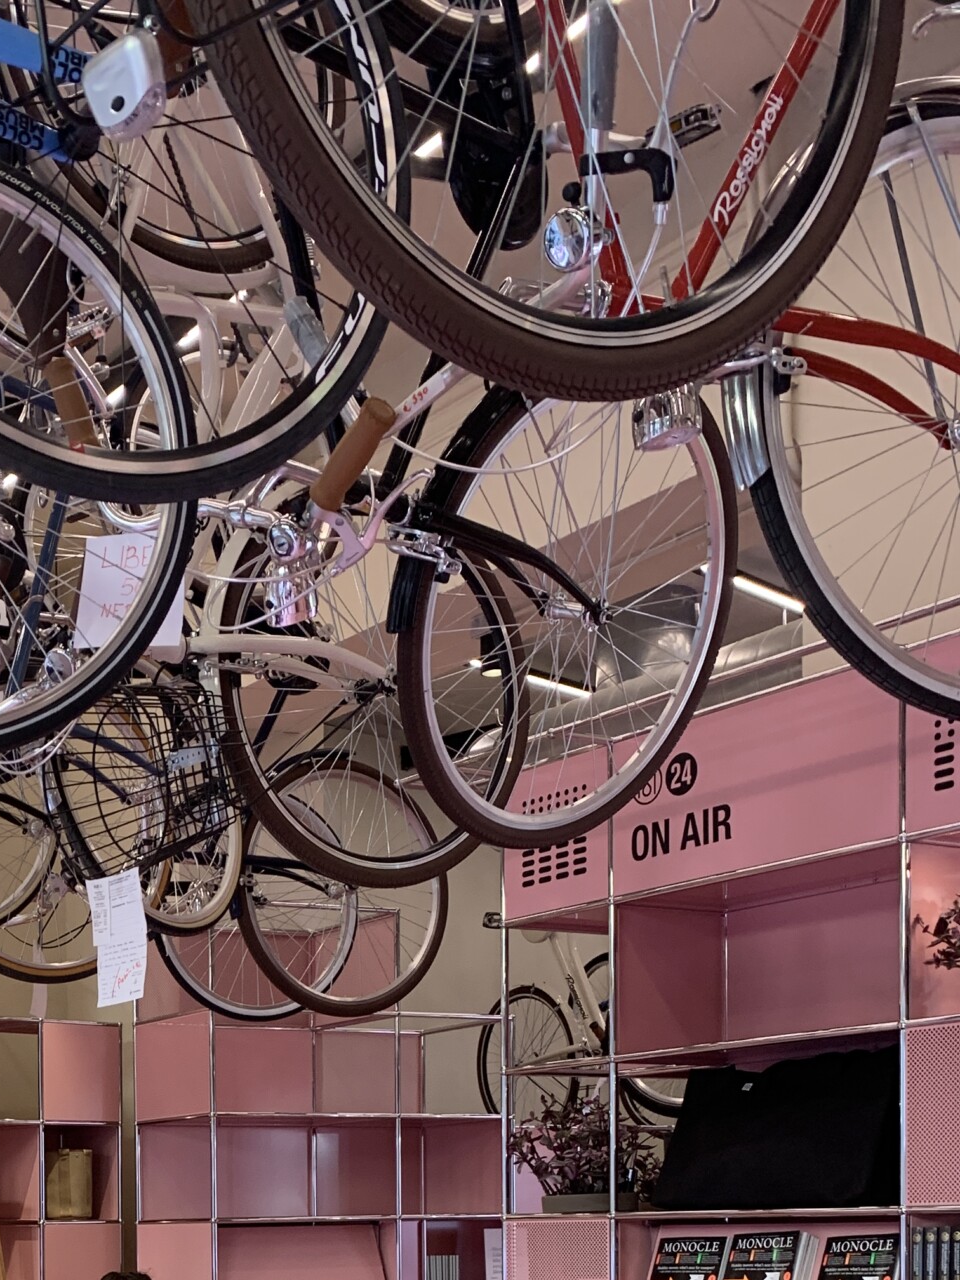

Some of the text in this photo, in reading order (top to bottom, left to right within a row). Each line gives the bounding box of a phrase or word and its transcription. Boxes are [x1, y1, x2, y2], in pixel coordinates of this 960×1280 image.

[101, 544, 152, 569] LIBE
[670, 759, 692, 790] 24
[632, 804, 732, 862] ON AIR
[662, 1242, 720, 1253] MONOCLE
[736, 1236, 794, 1250] MONOCLE
[830, 1239, 894, 1253] MONOCLE
